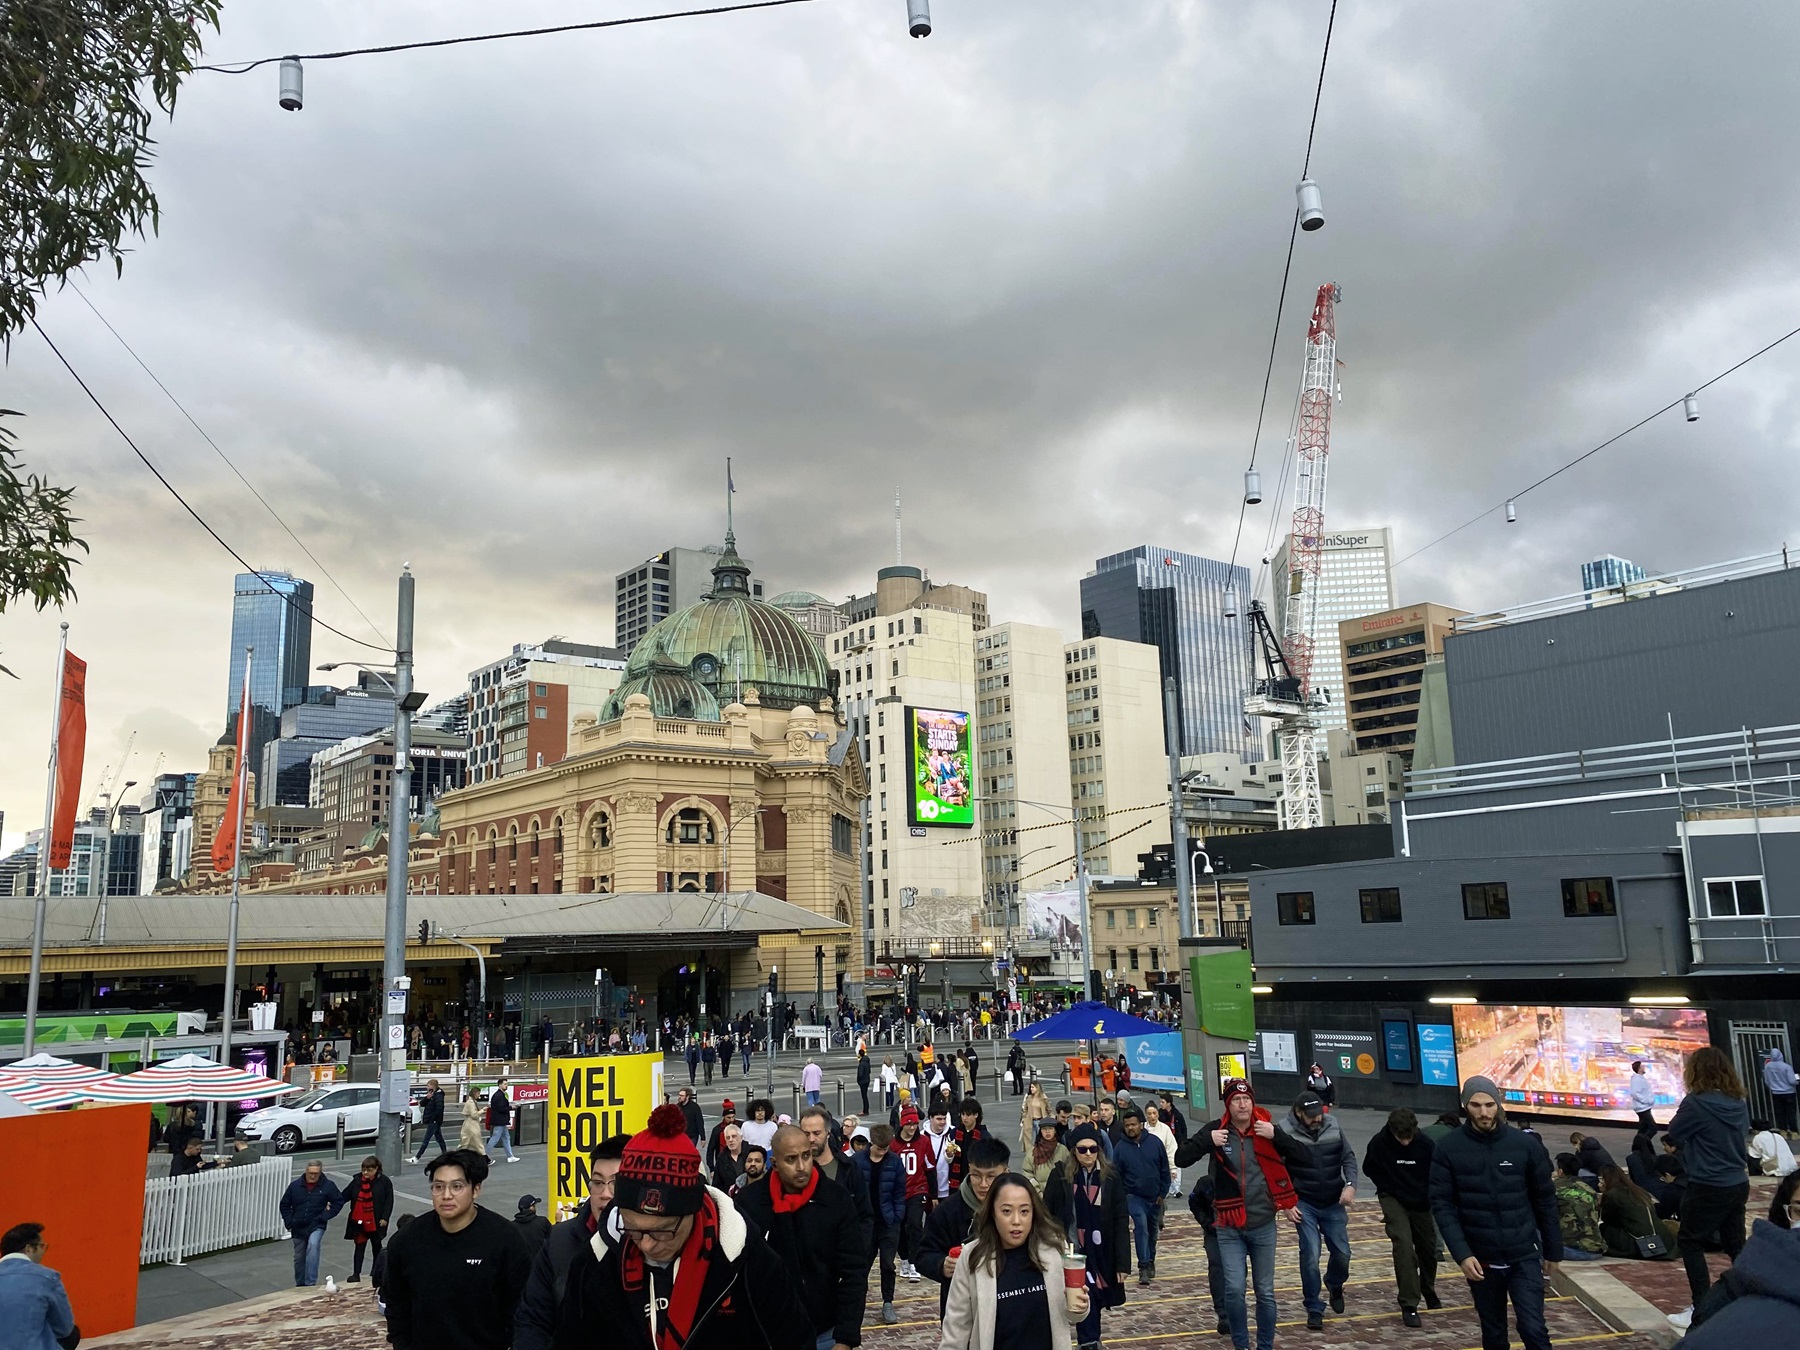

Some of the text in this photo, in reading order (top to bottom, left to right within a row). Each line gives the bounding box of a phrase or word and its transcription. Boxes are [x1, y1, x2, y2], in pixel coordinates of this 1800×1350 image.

[1319, 534, 1368, 547] UniSuper
[1362, 615, 1405, 631] Emirates
[928, 728, 957, 741] STARTS
[927, 738, 958, 751] SUNDAY
[519, 1089, 542, 1098] Grand
[557, 1066, 624, 1108] MEL
[557, 1110, 623, 1153] BOU
[900, 1152, 917, 1175] 10
